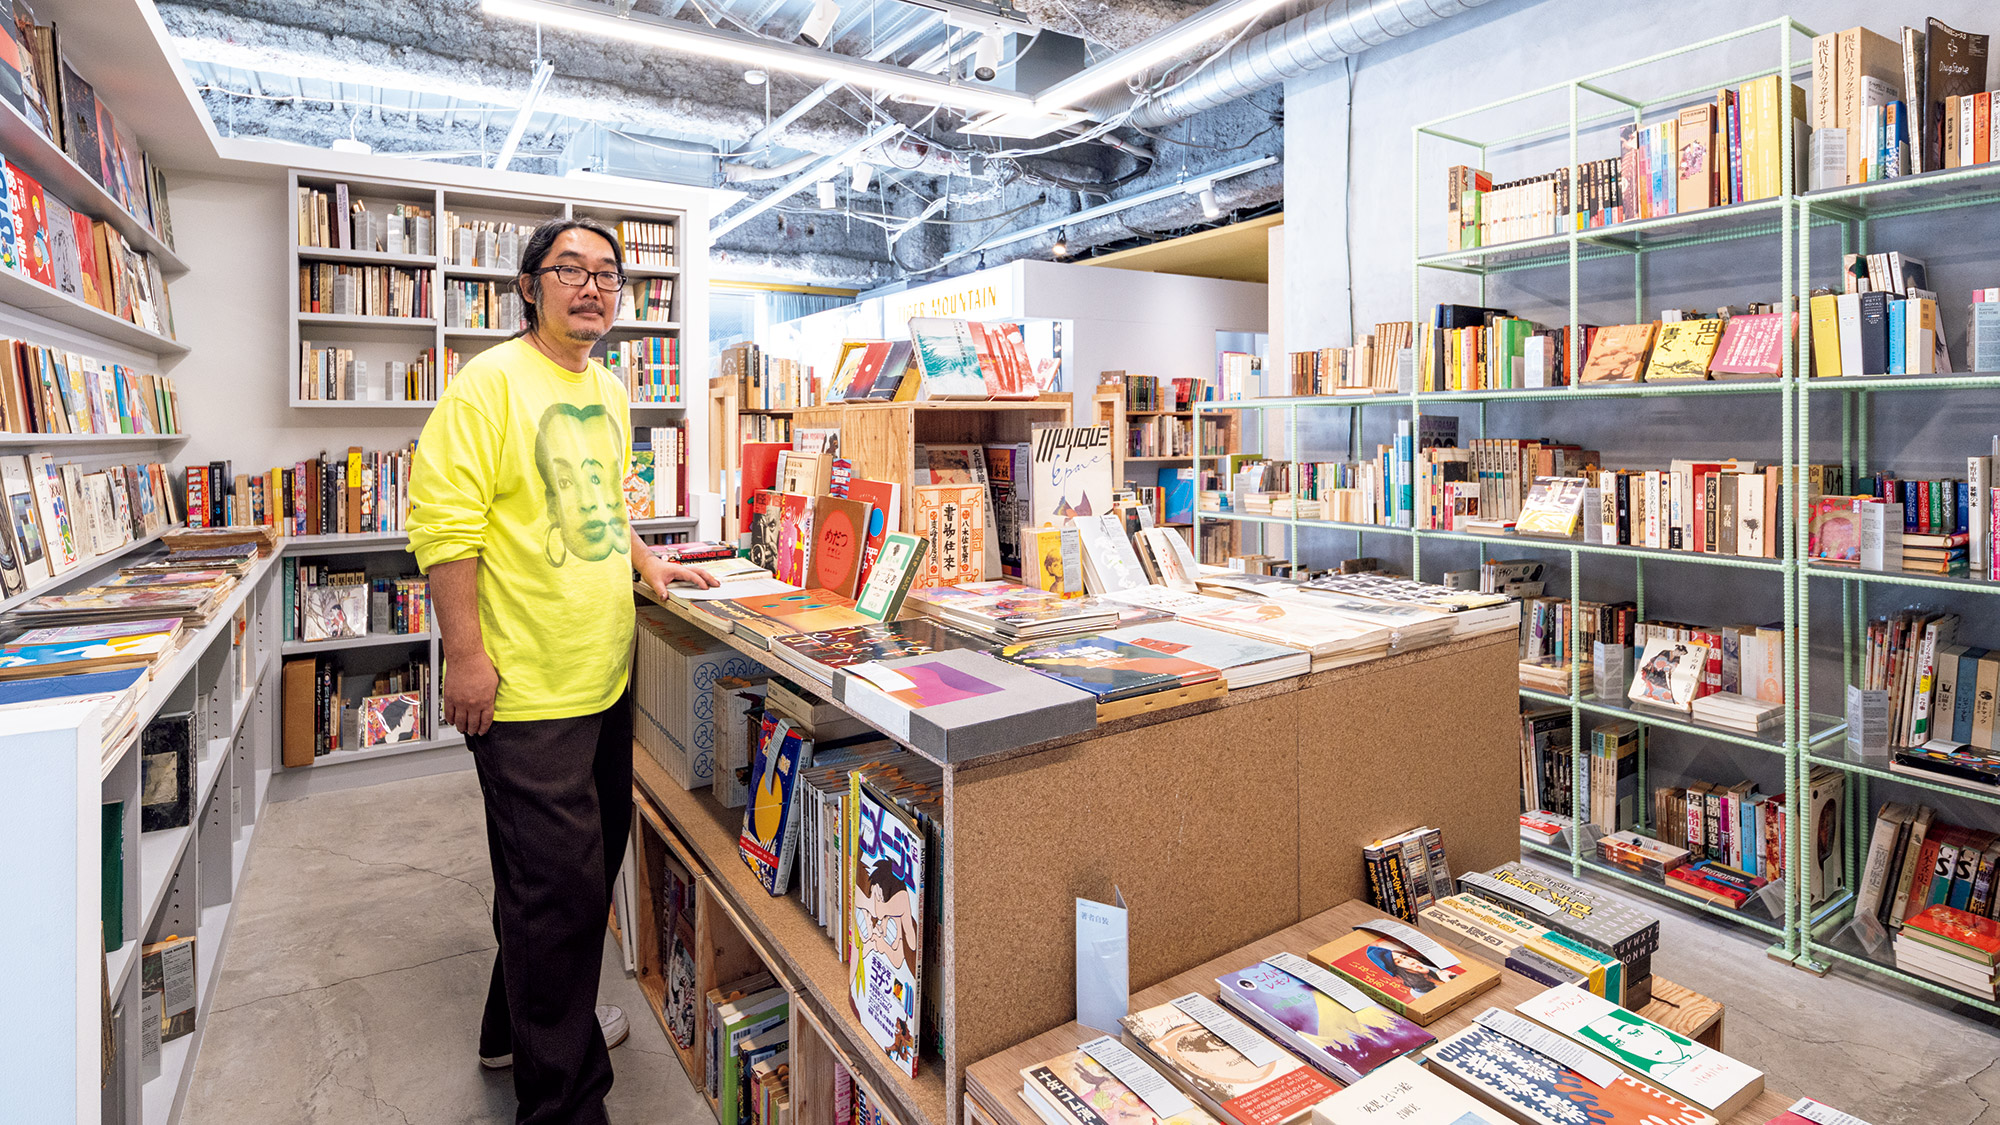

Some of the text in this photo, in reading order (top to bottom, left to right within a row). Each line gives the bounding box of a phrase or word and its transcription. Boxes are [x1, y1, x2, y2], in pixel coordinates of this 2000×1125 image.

[931, 285, 997, 317] MOUNTAIN
[825, 528, 848, 547] めだつ
